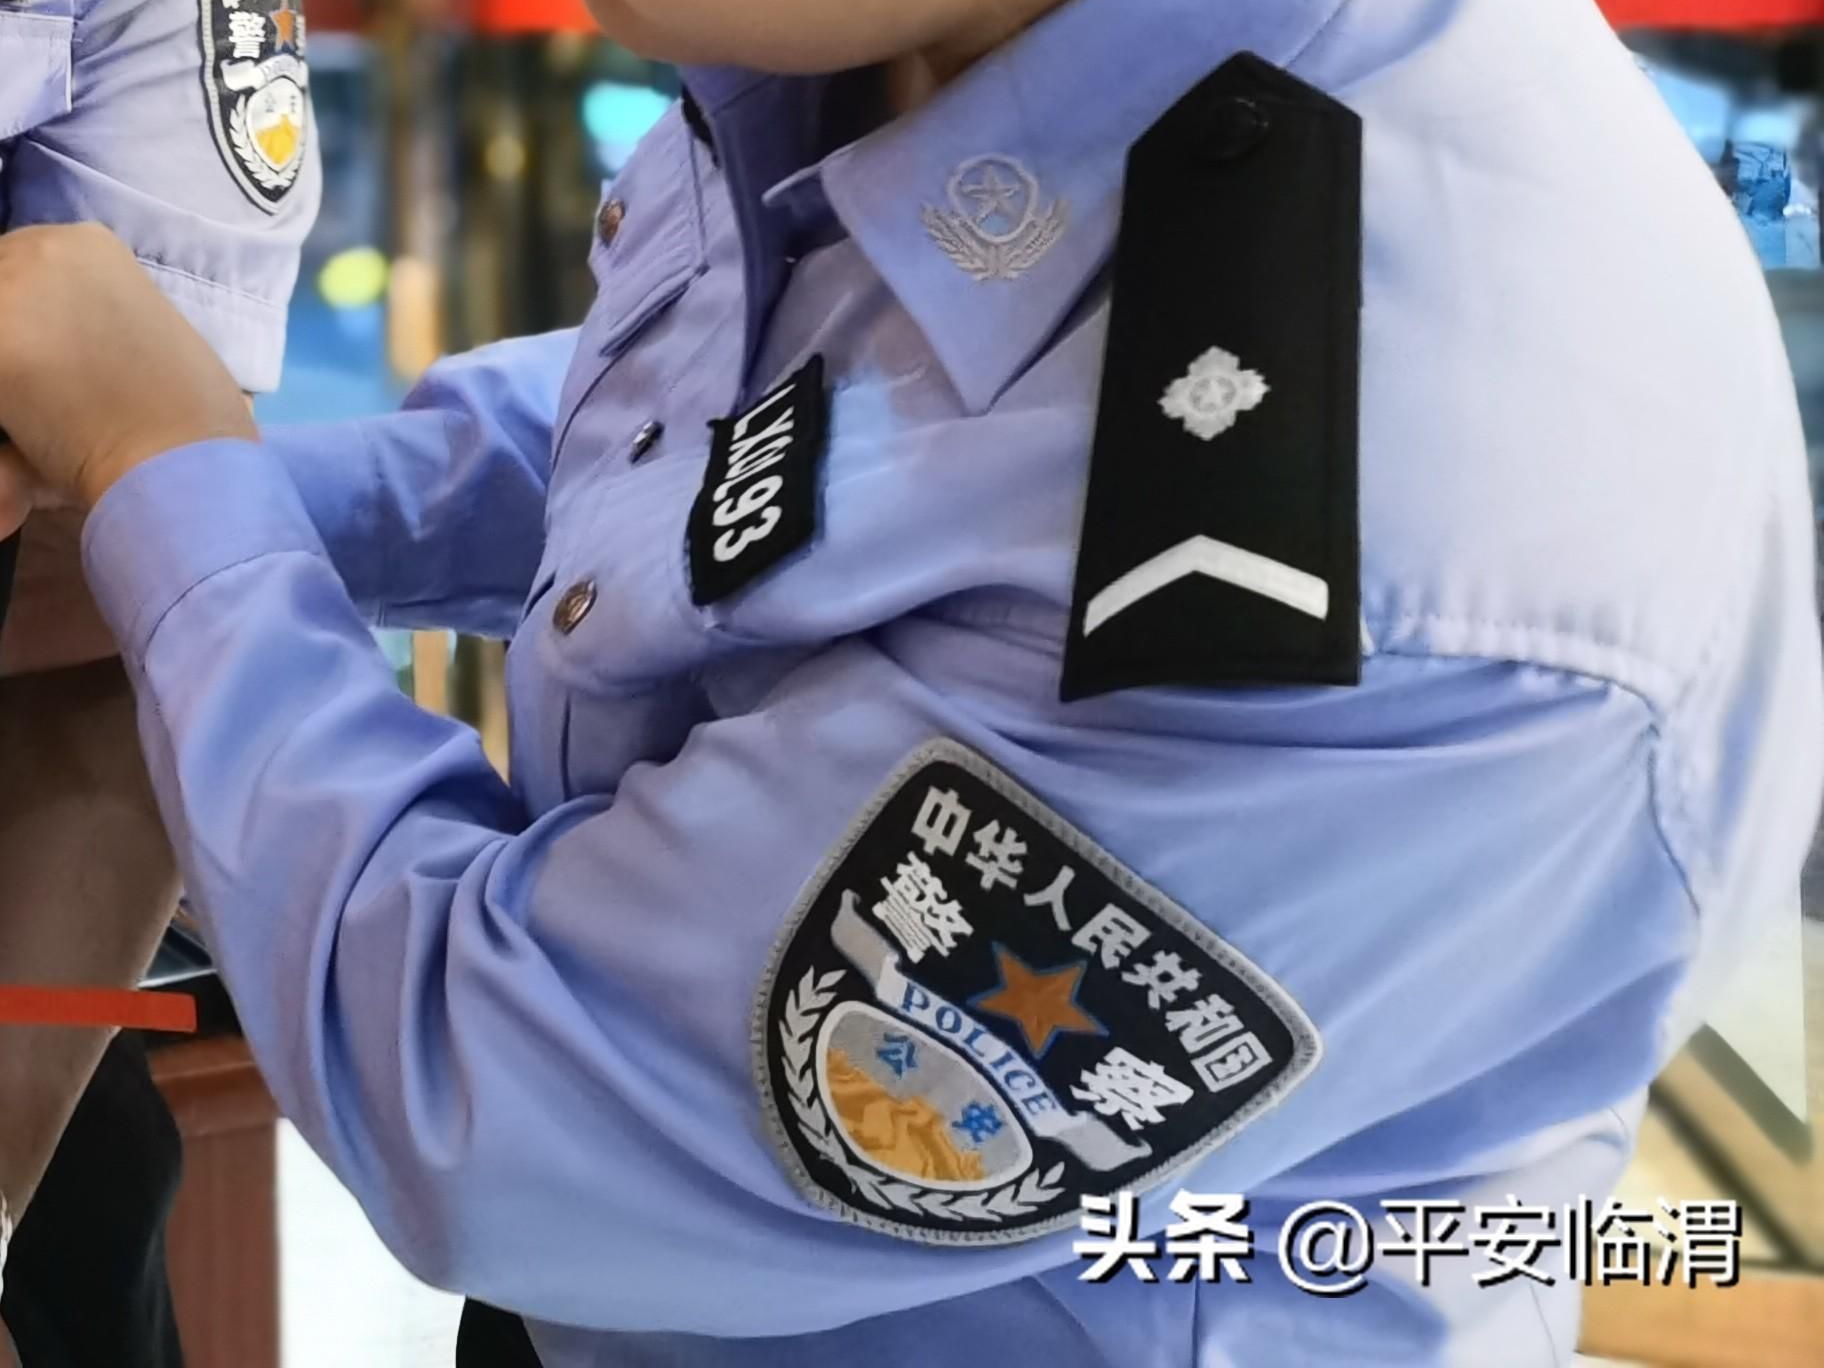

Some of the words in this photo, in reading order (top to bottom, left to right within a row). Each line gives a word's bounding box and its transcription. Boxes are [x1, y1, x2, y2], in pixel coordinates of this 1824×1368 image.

[900, 979, 1060, 1118] POLICE
[911, 786, 1273, 1093] 中华人民共和国
